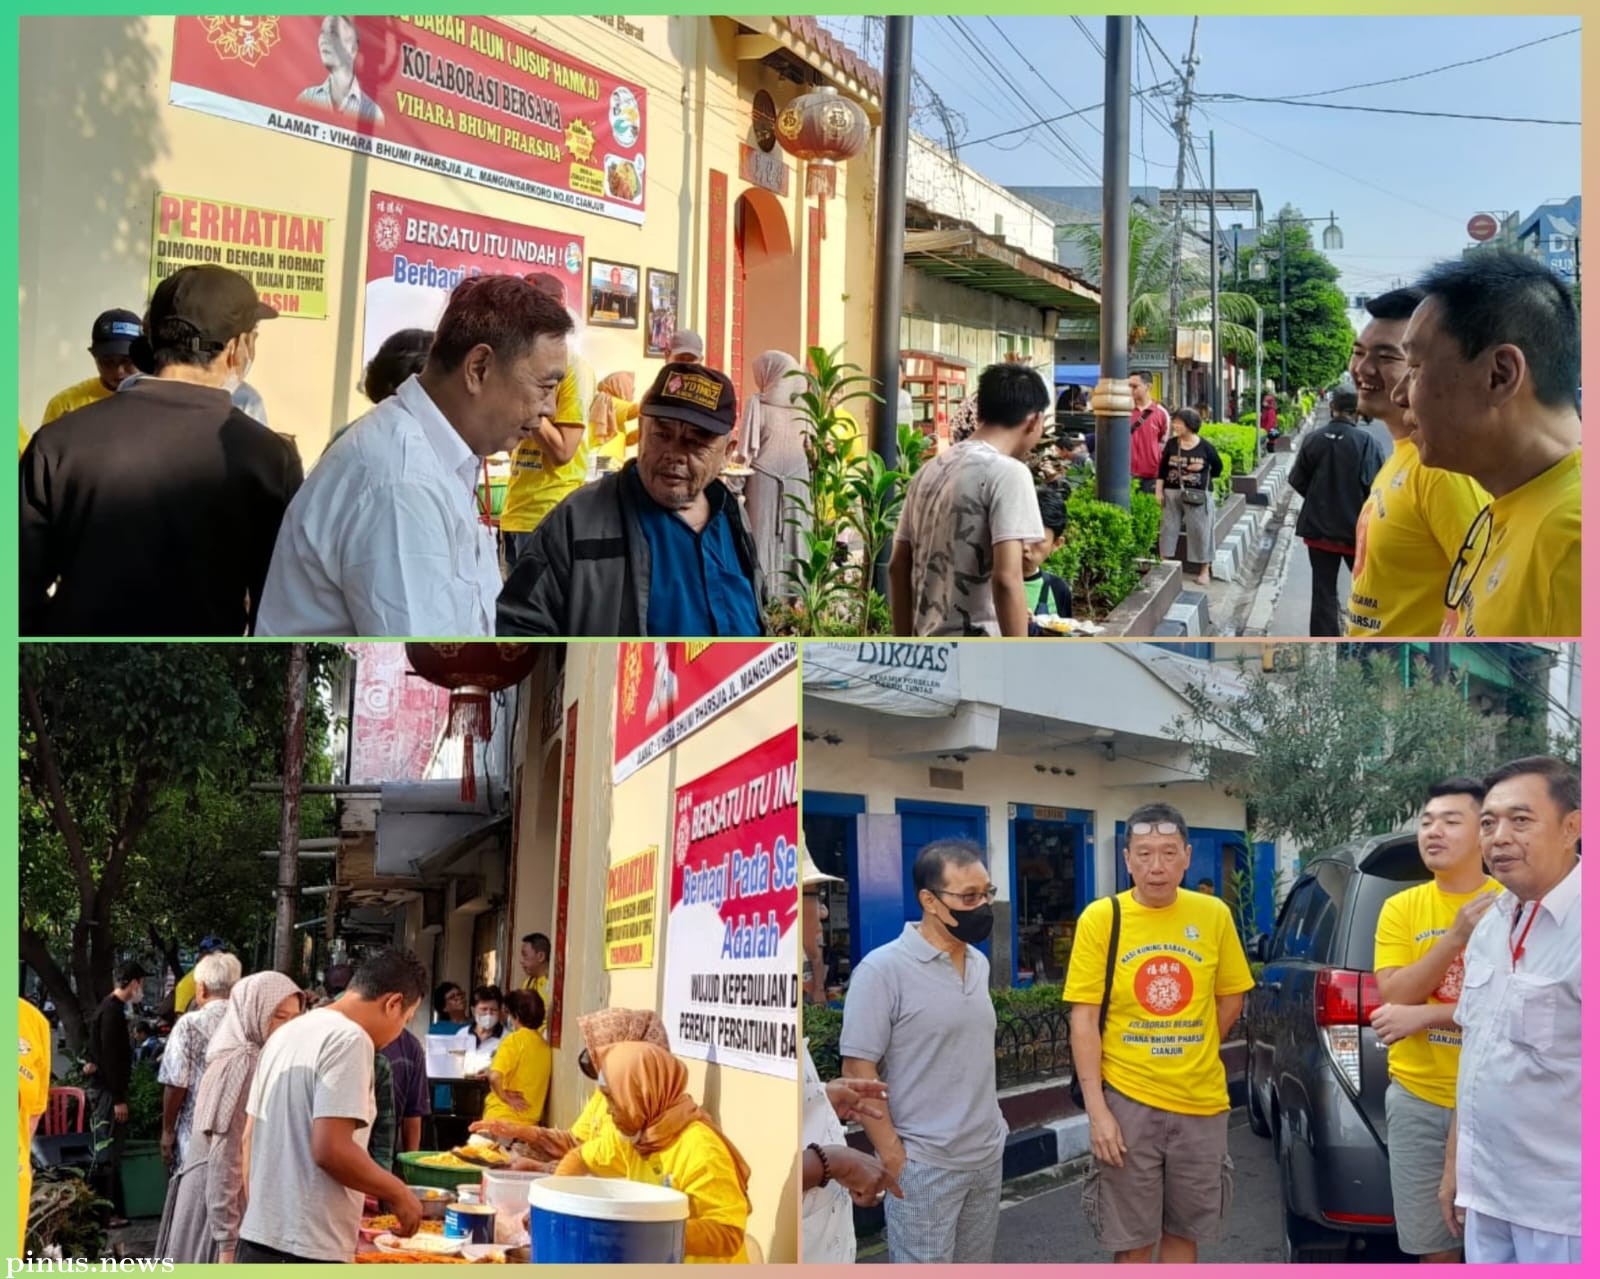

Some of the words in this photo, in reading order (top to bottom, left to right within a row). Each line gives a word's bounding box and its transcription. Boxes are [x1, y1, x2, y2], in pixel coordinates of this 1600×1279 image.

[469, 24, 505, 62] ALUN
[507, 41, 551, 79] (JUSUF
[553, 60, 600, 101] HAMKA)
[401, 44, 500, 108] KOLABORASI
[502, 82, 562, 131] BERSAMA
[396, 92, 455, 130] VIHARA
[458, 112, 502, 144] BHUMI
[504, 128, 562, 163] PHARSJIA
[267, 113, 319, 137] ALAMAT
[330, 129, 373, 151] VIHARA
[376, 142, 412, 162] BHUMI
[413, 152, 462, 175] PHARSJIA
[464, 165, 477, 179] JL.
[479, 171, 552, 198] MANGUNSARKORO
[575, 196, 605, 212] CIANJUR
[159, 196, 324, 254] PERHATIAN
[405, 217, 480, 253] BERSATU
[483, 233, 509, 258] ITU
[511, 238, 556, 266] INDAH
[157, 240, 221, 263] DIMOHON
[226, 248, 274, 269] DENGAN
[278, 255, 325, 273] HORMAT
[256, 271, 283, 288] MAKAN
[286, 275, 295, 290] DI
[297, 275, 324, 292] TEMPAT
[260, 292, 300, 313] ASIH
[857, 641, 949, 673] DIKUAS
[691, 784, 746, 841] BERSATU
[746, 772, 772, 820] ITU
[683, 852, 730, 909] Berbagi
[730, 843, 770, 899] Pada
[773, 836, 798, 890] Se
[721, 912, 779, 960] Adalah
[691, 973, 720, 1003] WUJUD
[722, 973, 787, 1008] KEPEDULIAN
[680, 1012, 716, 1045] PEREKAT
[717, 1016, 777, 1056] PERSATUAN
[1150, 1035, 1177, 1044] BHUMI
[1151, 1046, 1184, 1056] CIANJUR
